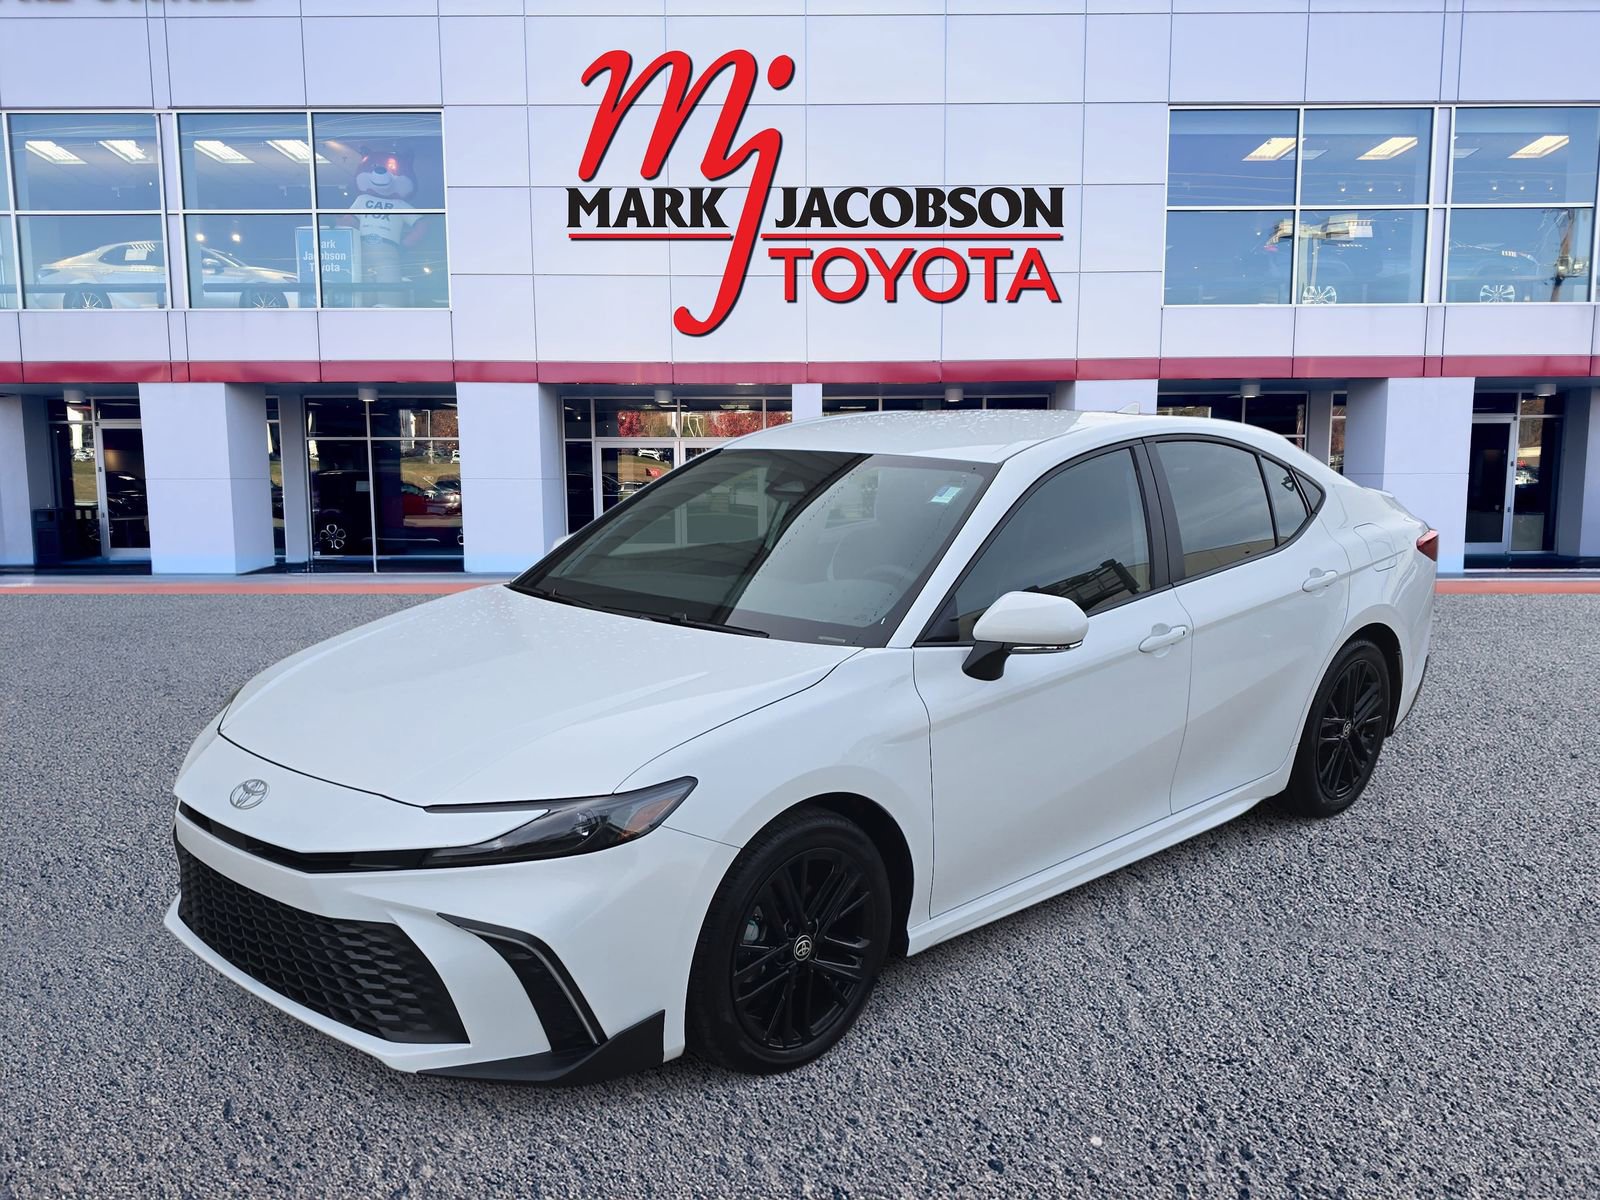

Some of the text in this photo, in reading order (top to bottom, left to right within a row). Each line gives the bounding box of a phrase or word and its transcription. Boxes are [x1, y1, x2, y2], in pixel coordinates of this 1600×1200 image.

[566, 187, 1064, 228] MARK JACOBSON
[303, 251, 346, 261] Jabson
[309, 262, 341, 273] Tyota
[768, 247, 1062, 303] TOYOTA
